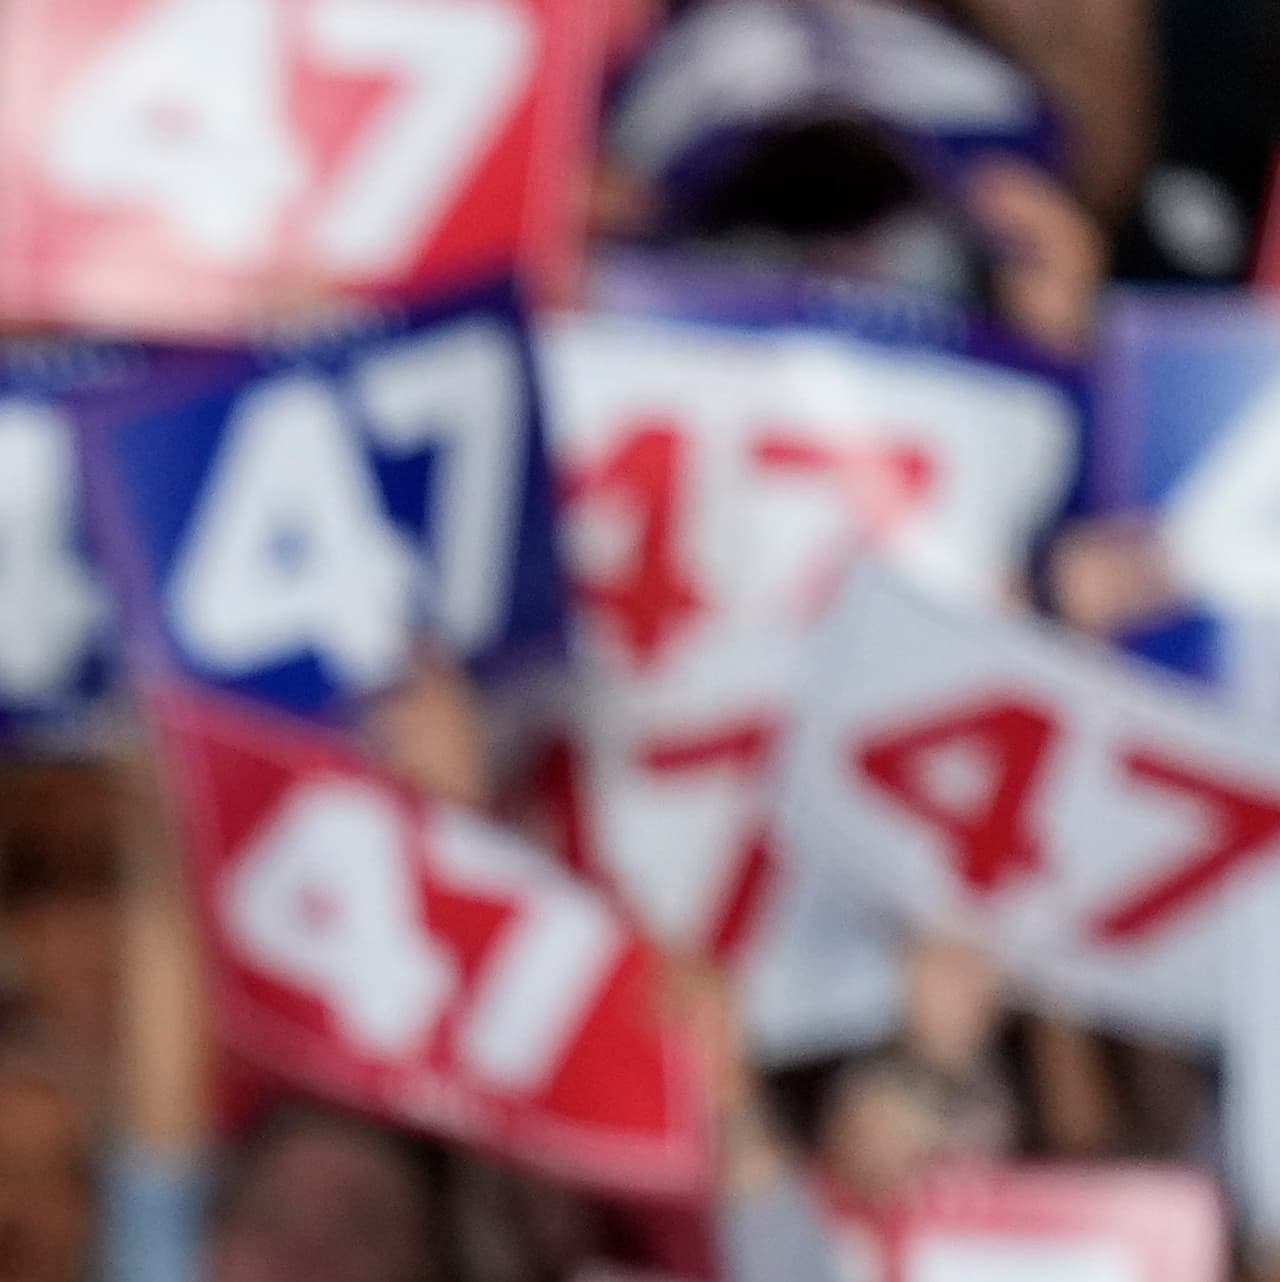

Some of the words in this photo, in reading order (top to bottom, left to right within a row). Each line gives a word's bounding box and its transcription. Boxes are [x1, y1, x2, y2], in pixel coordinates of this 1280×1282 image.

[50, 0, 535, 268] 47
[168, 315, 528, 695] 47
[220, 775, 630, 1105] 47
[850, 690, 1280, 950] 47
